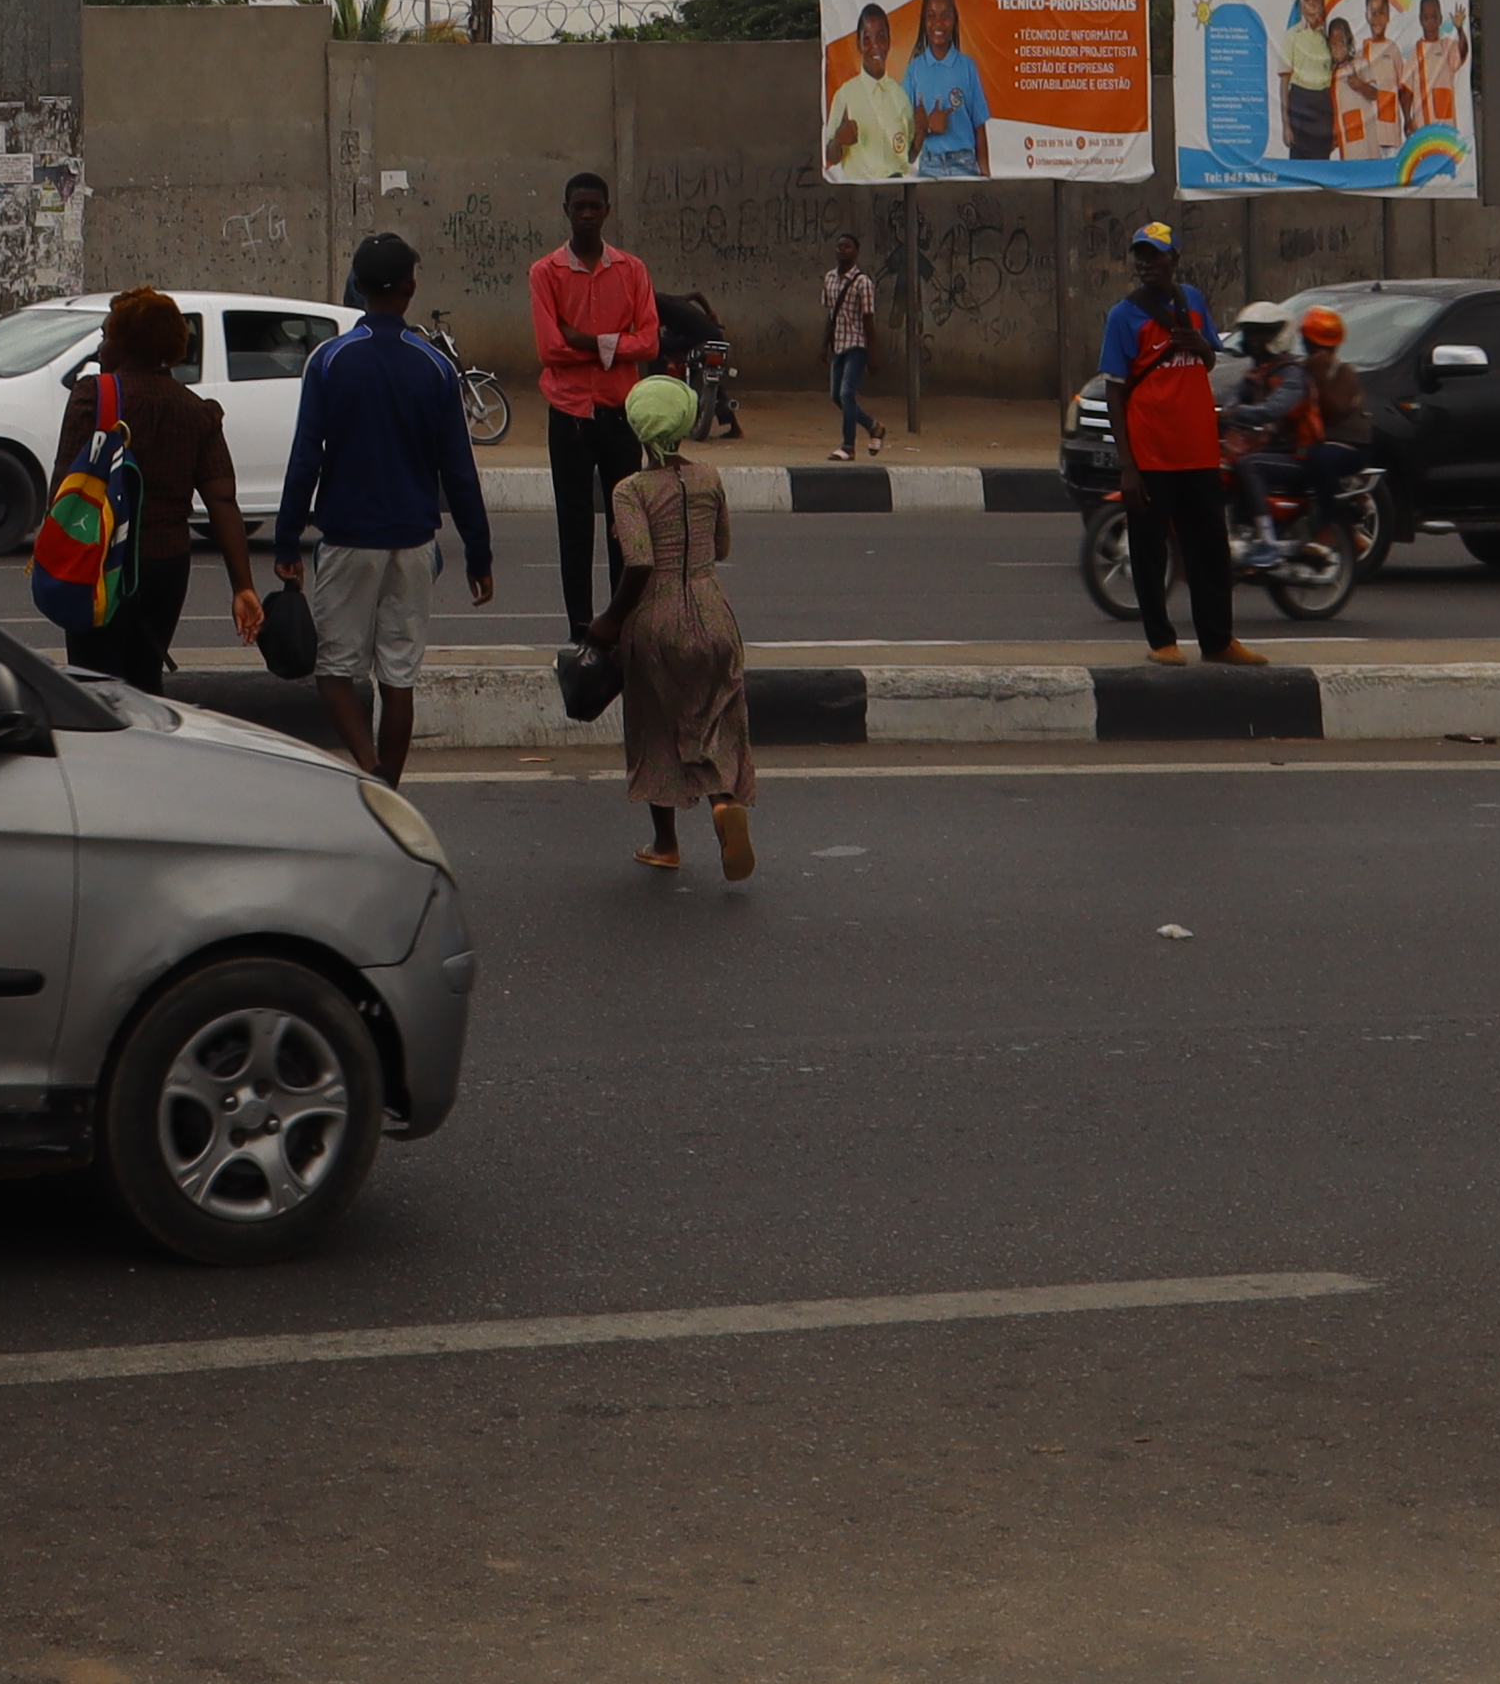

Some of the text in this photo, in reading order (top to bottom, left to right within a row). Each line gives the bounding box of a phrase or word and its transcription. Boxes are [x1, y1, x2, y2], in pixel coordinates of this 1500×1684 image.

[1020, 27, 1128, 41] TÉCNICO DE INFORMÁTICA
[1020, 46, 1137, 58] DESENHADOR PROJECTISTA
[1020, 60, 1114, 74] GESTÃO DE EMPRESAS
[1020, 76, 1130, 90] CONTABILIDADE E GESTÃO
[1203, 172, 1222, 183] Tel:
